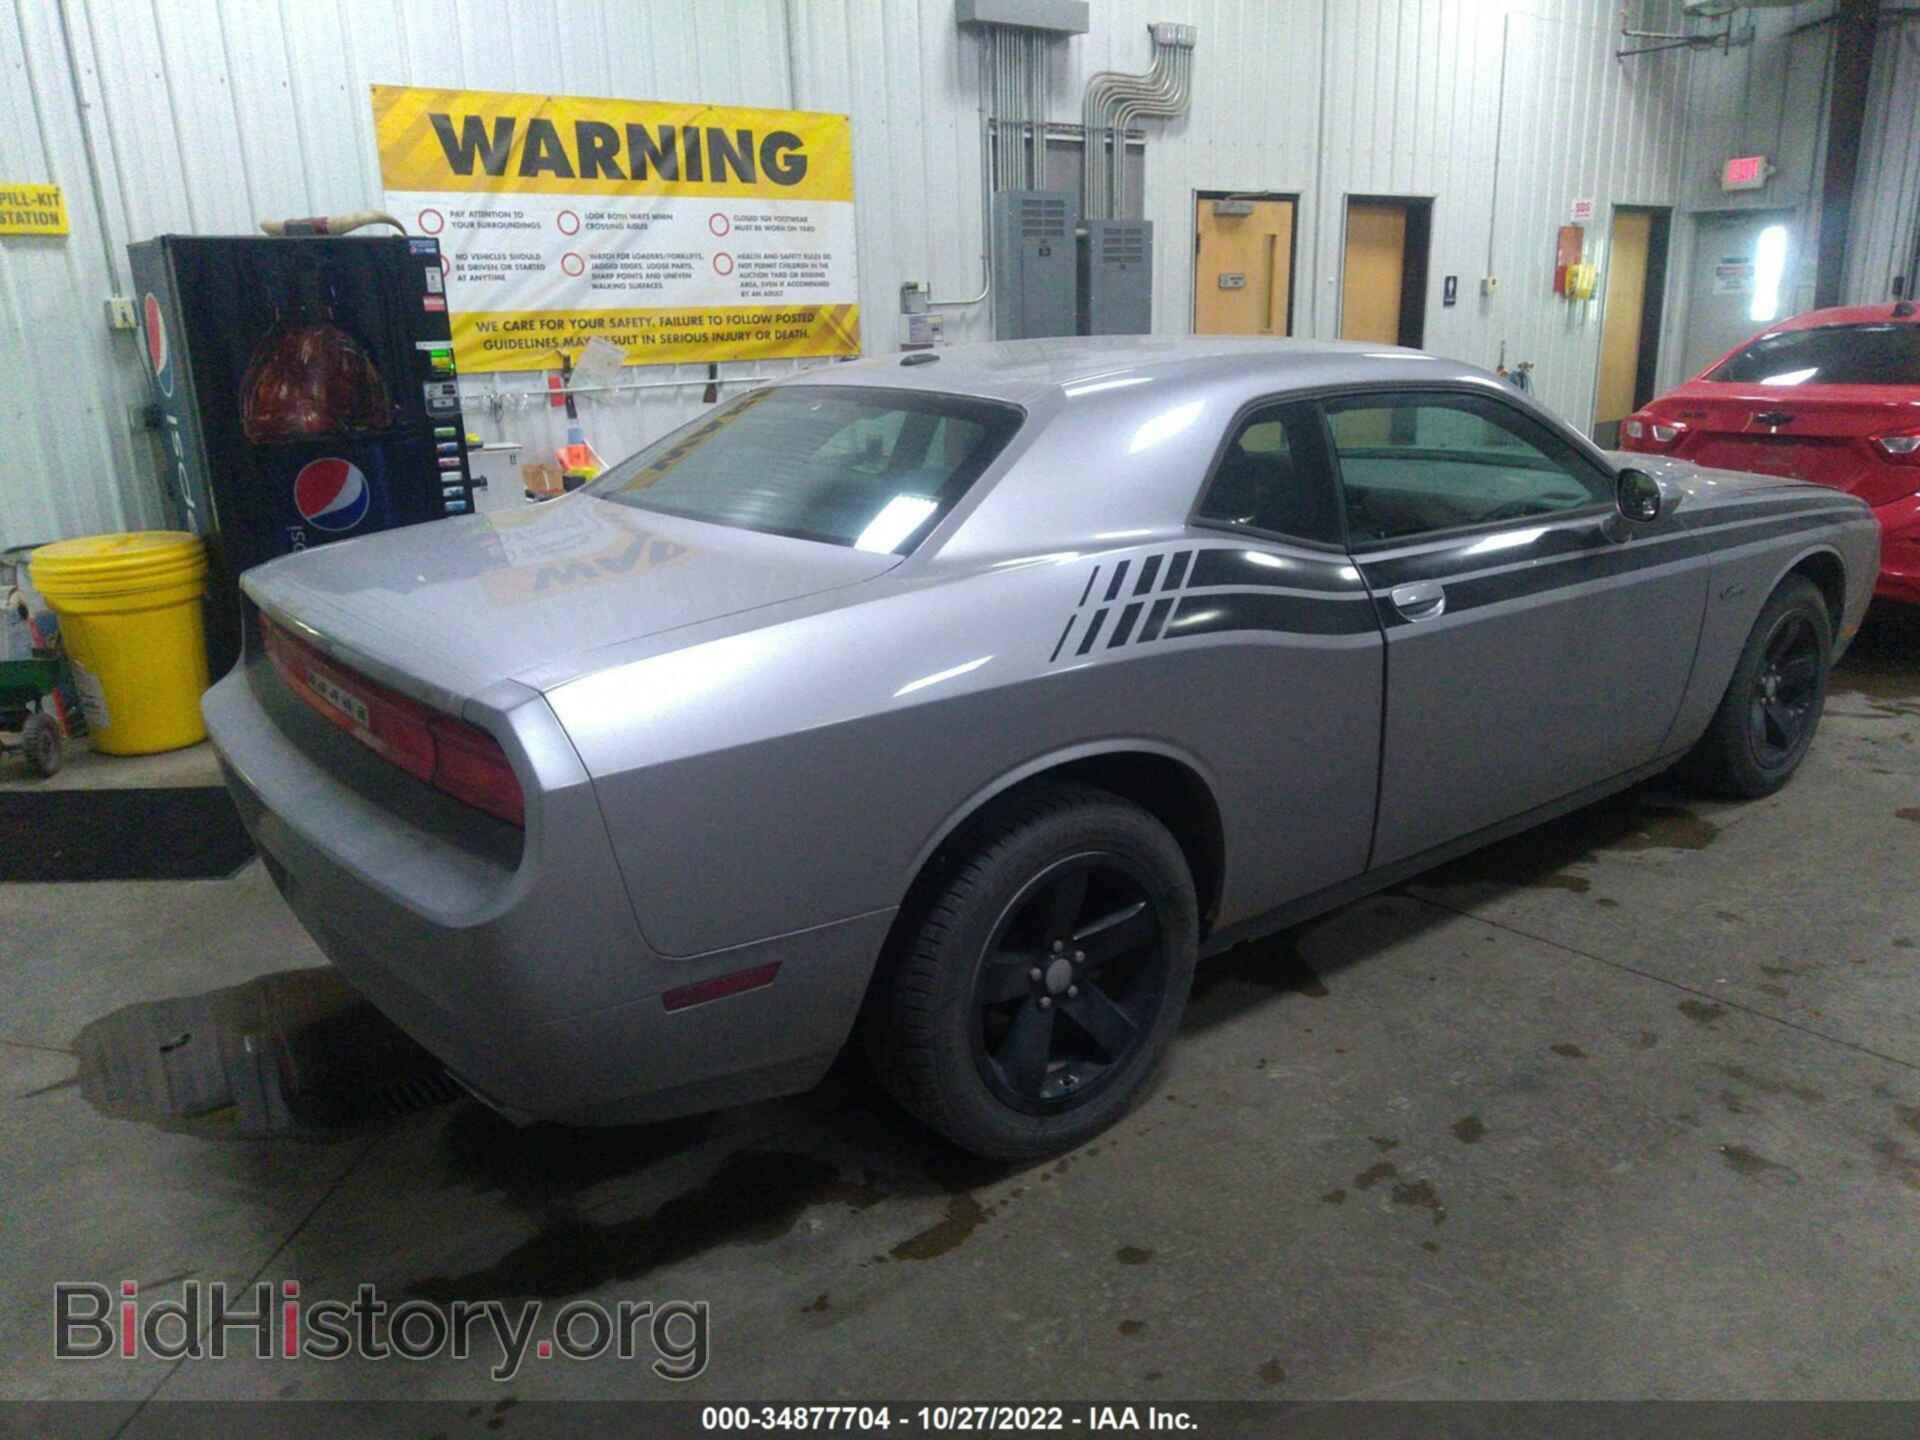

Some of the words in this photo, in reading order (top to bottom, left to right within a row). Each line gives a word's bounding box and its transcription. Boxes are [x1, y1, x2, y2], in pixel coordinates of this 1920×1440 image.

[428, 113, 808, 186] WARNING
[475, 321, 499, 332] WE
[503, 320, 536, 332] CARE
[540, 319, 565, 330] FOR
[569, 317, 605, 329] YOUR
[659, 315, 704, 327] FAILURE
[708, 315, 723, 326] TO
[726, 314, 772, 325] FOLLOW
[775, 312, 815, 324] POSTED
[482, 337, 559, 351] GUIDELINES
[561, 336, 592, 348] MAY
[642, 334, 656, 345] IN
[660, 332, 708, 344] SERIOUS
[712, 331, 752, 342] INJURY
[755, 330, 770, 341] OR
[775, 328, 810, 340] DEATH.
